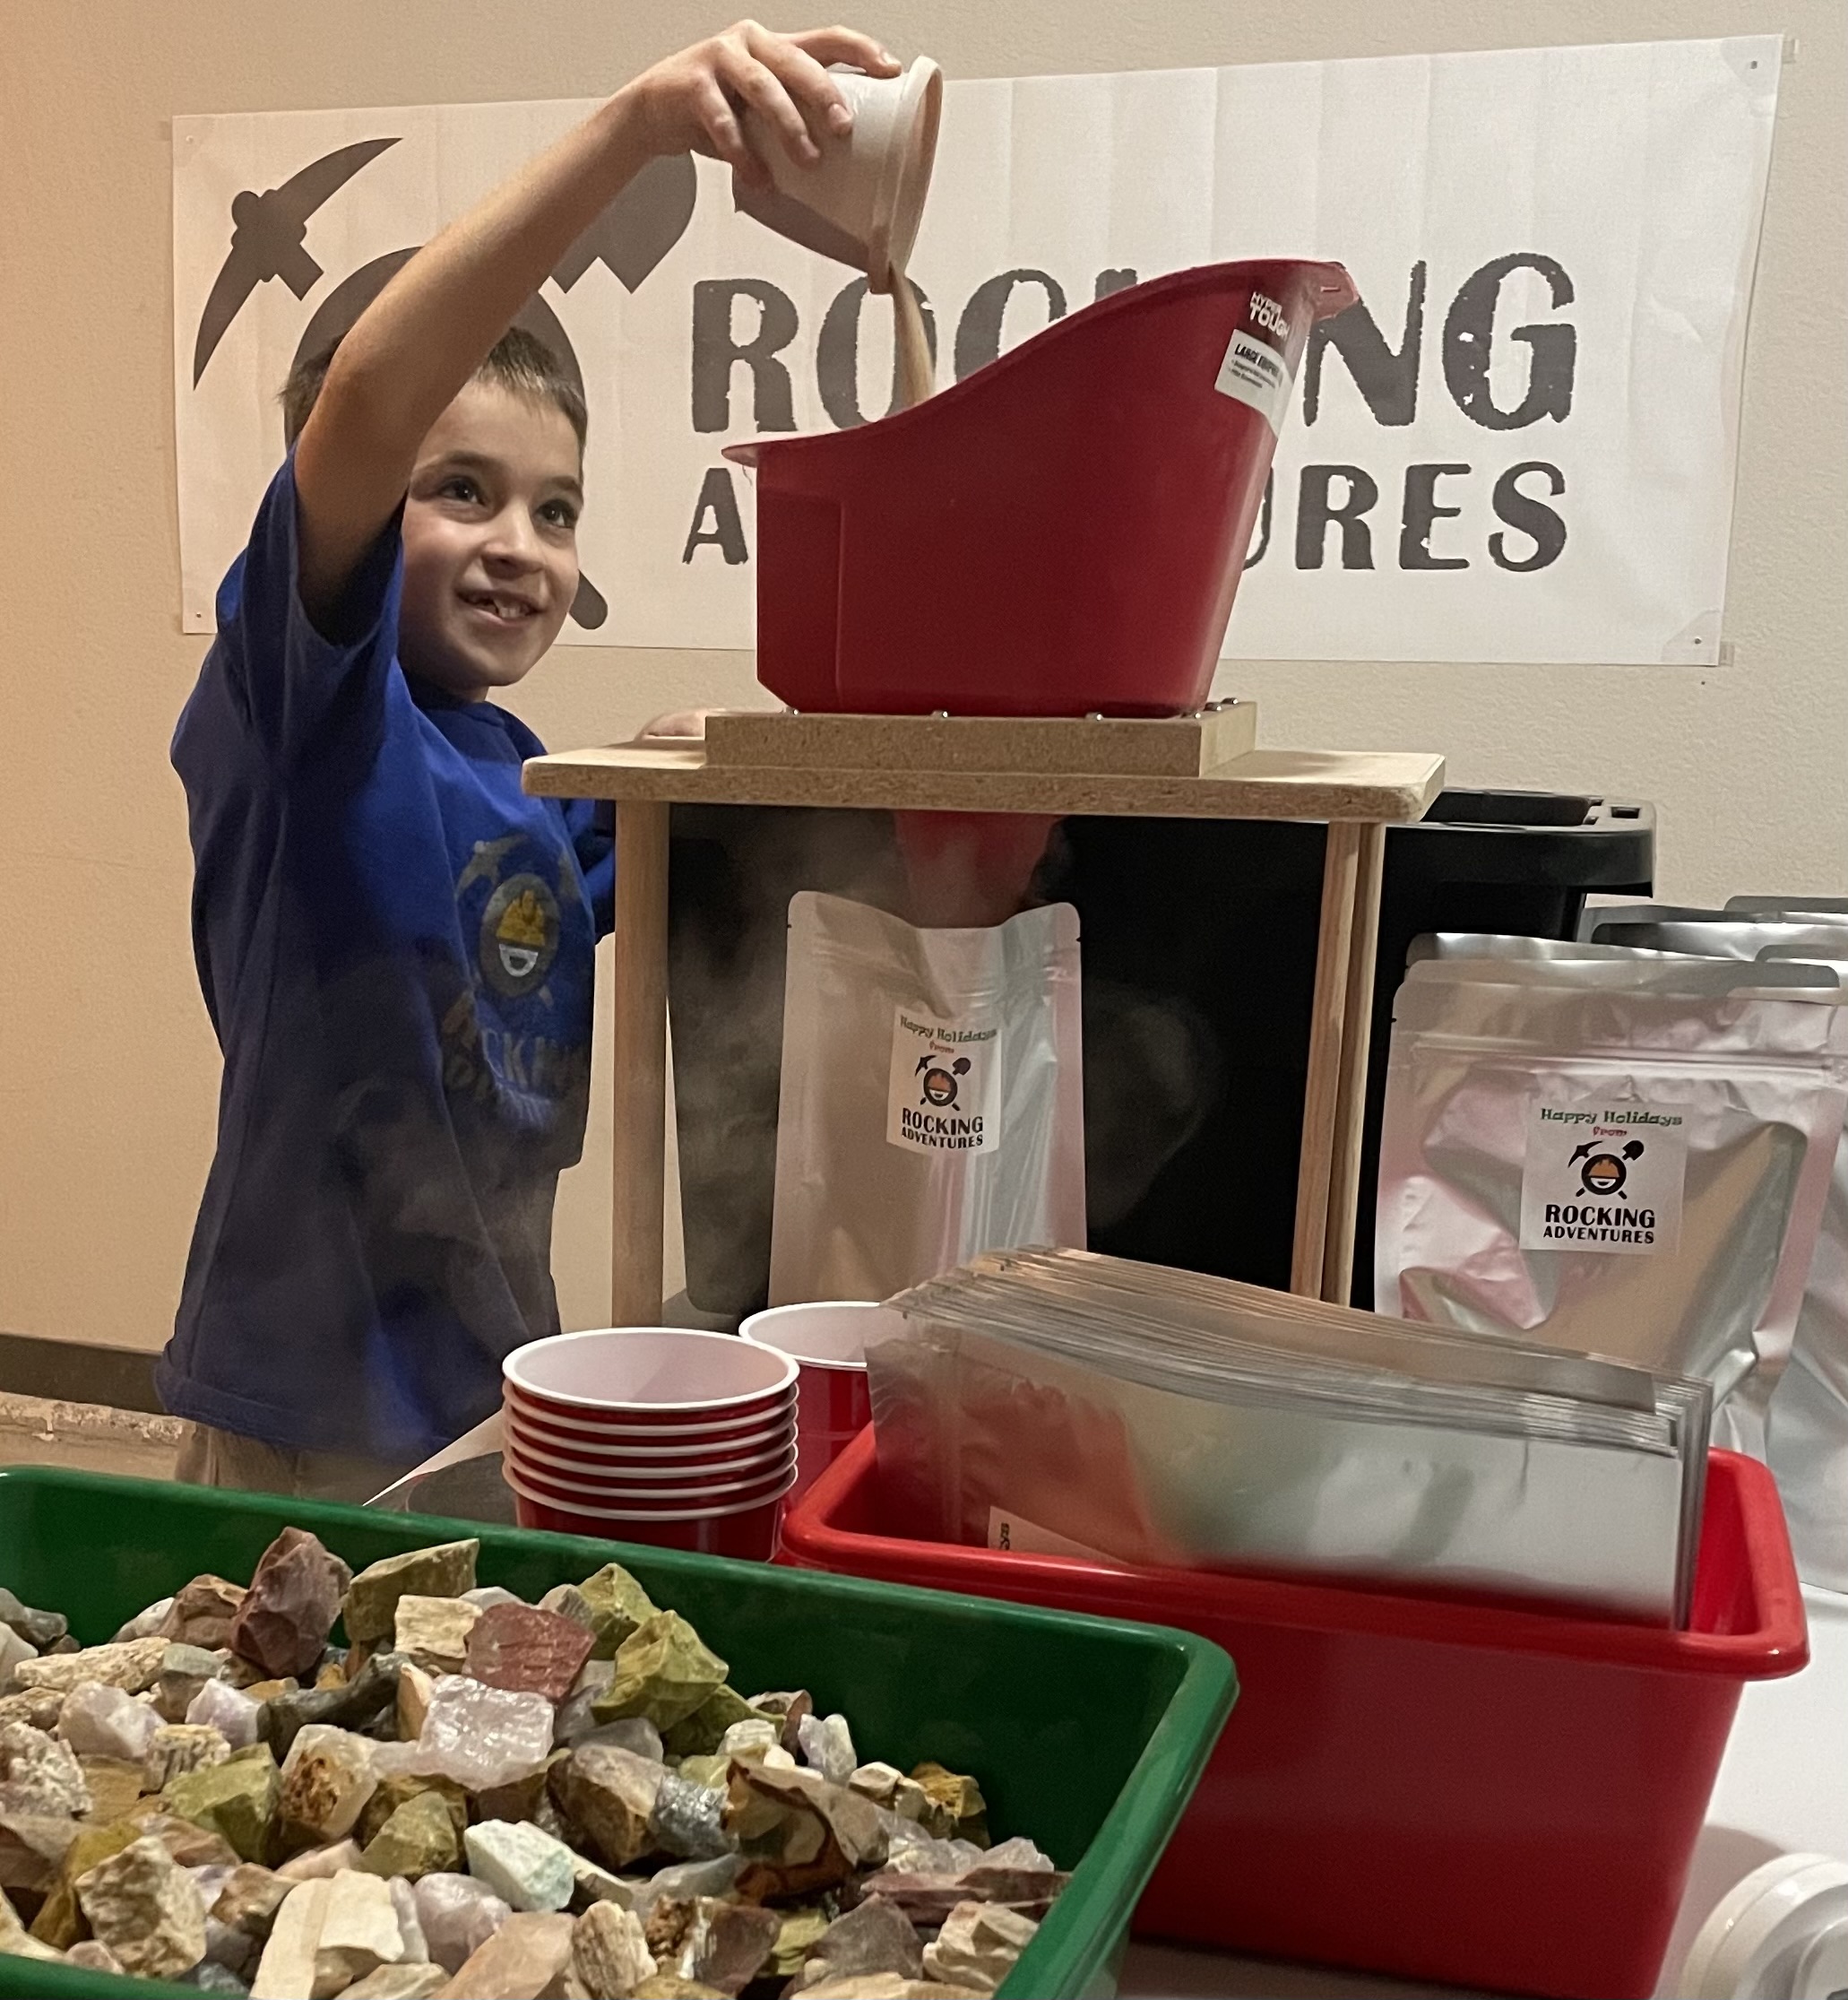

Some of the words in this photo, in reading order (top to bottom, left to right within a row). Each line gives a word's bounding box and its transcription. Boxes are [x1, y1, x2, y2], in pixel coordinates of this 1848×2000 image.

[1249, 291, 1282, 314] HYPER
[1249, 304, 1291, 342] TOUGH
[692, 252, 1576, 433] ROCNG
[900, 1015, 934, 1039] Happy
[902, 1107, 983, 1136] ROCKING
[1541, 1108, 1598, 1124] Happy
[1603, 1111, 1683, 1127] Holidays
[901, 1126, 983, 1149] ADVENTURES
[1545, 1204, 1655, 1228] ROCKING
[1543, 1225, 1654, 1244] ADVENTURES
